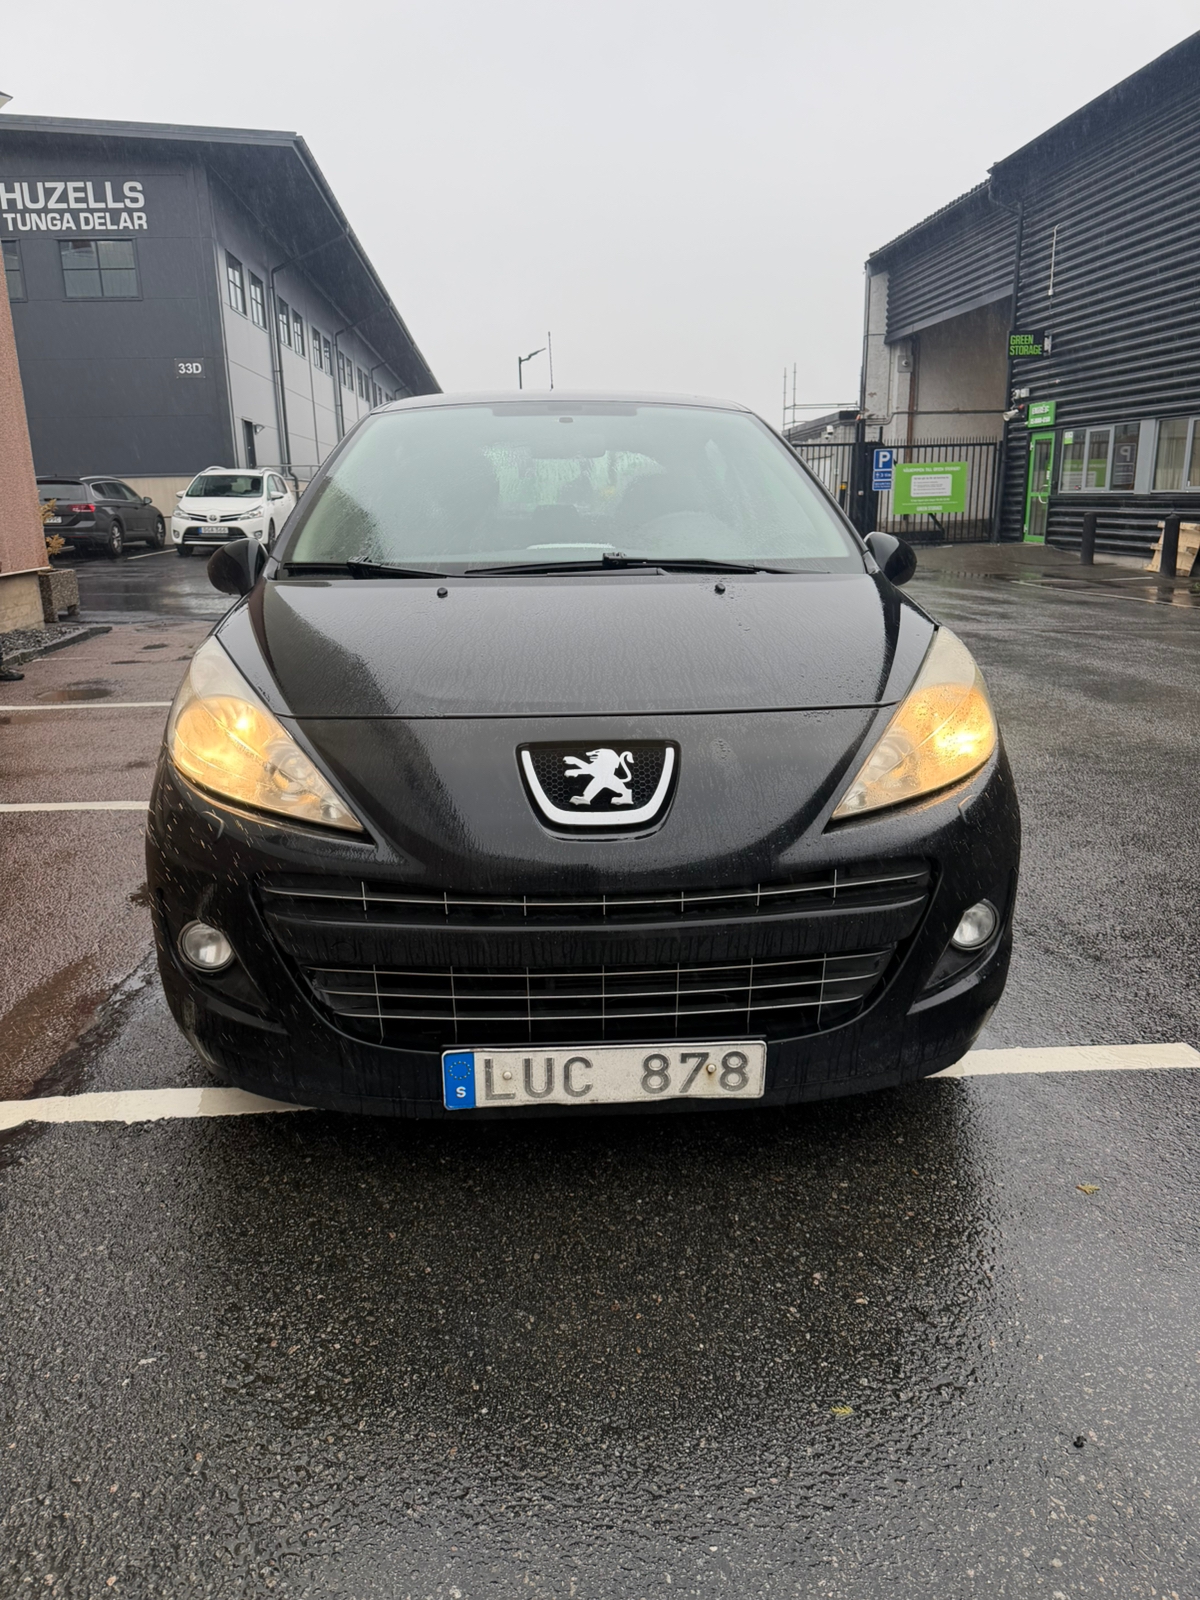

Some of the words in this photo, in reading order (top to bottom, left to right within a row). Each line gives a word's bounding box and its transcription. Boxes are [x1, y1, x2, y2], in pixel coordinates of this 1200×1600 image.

[0, 181, 145, 209] HUZELLS
[3, 213, 76, 231] TUNGA
[79, 212, 148, 230] DELAR
[1010, 335, 1034, 345] GREEN
[1009, 345, 1042, 356] STORAGE
[178, 363, 202, 374] 33D
[878, 451, 891, 468] P
[484, 1056, 593, 1100] LUC
[640, 1050, 750, 1094] 878
[456, 1086, 466, 1098] S
